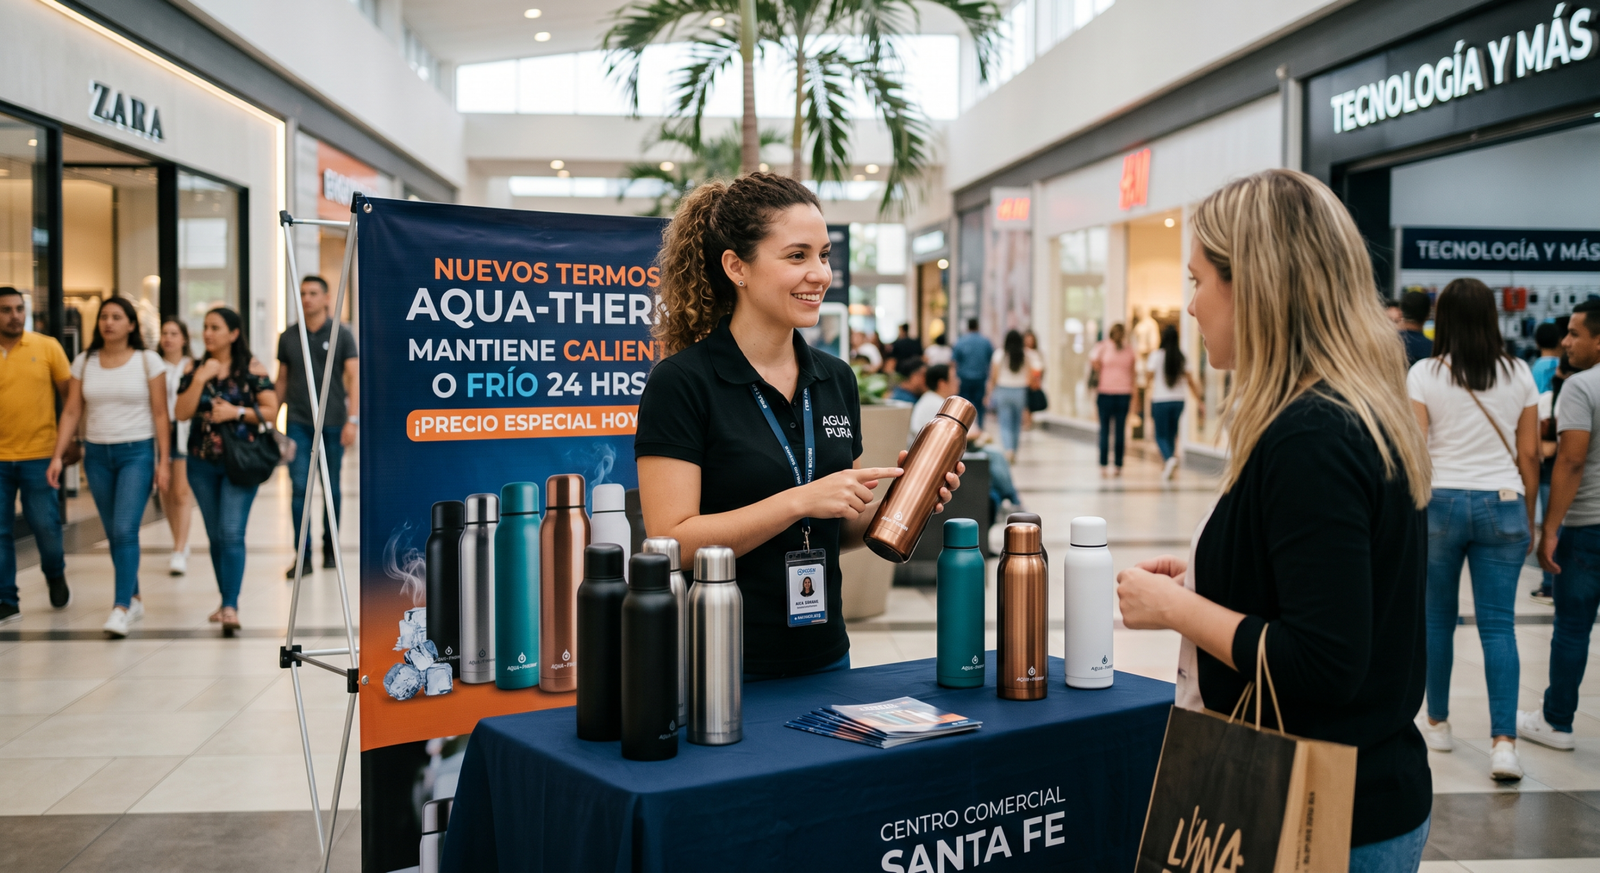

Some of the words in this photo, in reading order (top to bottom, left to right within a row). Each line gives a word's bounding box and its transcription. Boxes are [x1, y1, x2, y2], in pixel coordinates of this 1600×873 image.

[1330, 39, 1484, 134] TECNOLOGÍA
[1488, 36, 1511, 85] Y
[1515, 2, 1594, 78] MÁS
[89, 80, 165, 143] ZARA
[1416, 238, 1539, 262] TECNOLOGÍA
[1543, 242, 1556, 261] Y
[1560, 238, 1600, 262] MÁS
[434, 257, 549, 284] NUEVOS
[555, 263, 661, 288] TERMOS
[408, 338, 556, 362] MANTIENE
[431, 373, 457, 398] O
[467, 366, 538, 398] FRÍO
[546, 372, 583, 397] 24
[590, 371, 646, 396] HRS
[414, 415, 498, 437] ¡PRECIO
[504, 413, 597, 432] ESPECIAL
[822, 415, 851, 427] AGUA
[824, 427, 853, 438] PURA
[880, 810, 959, 842] CENTRO
[964, 786, 1066, 824] COMERCIAL
[881, 825, 1013, 873] SANTA
[1023, 810, 1066, 853] FE
